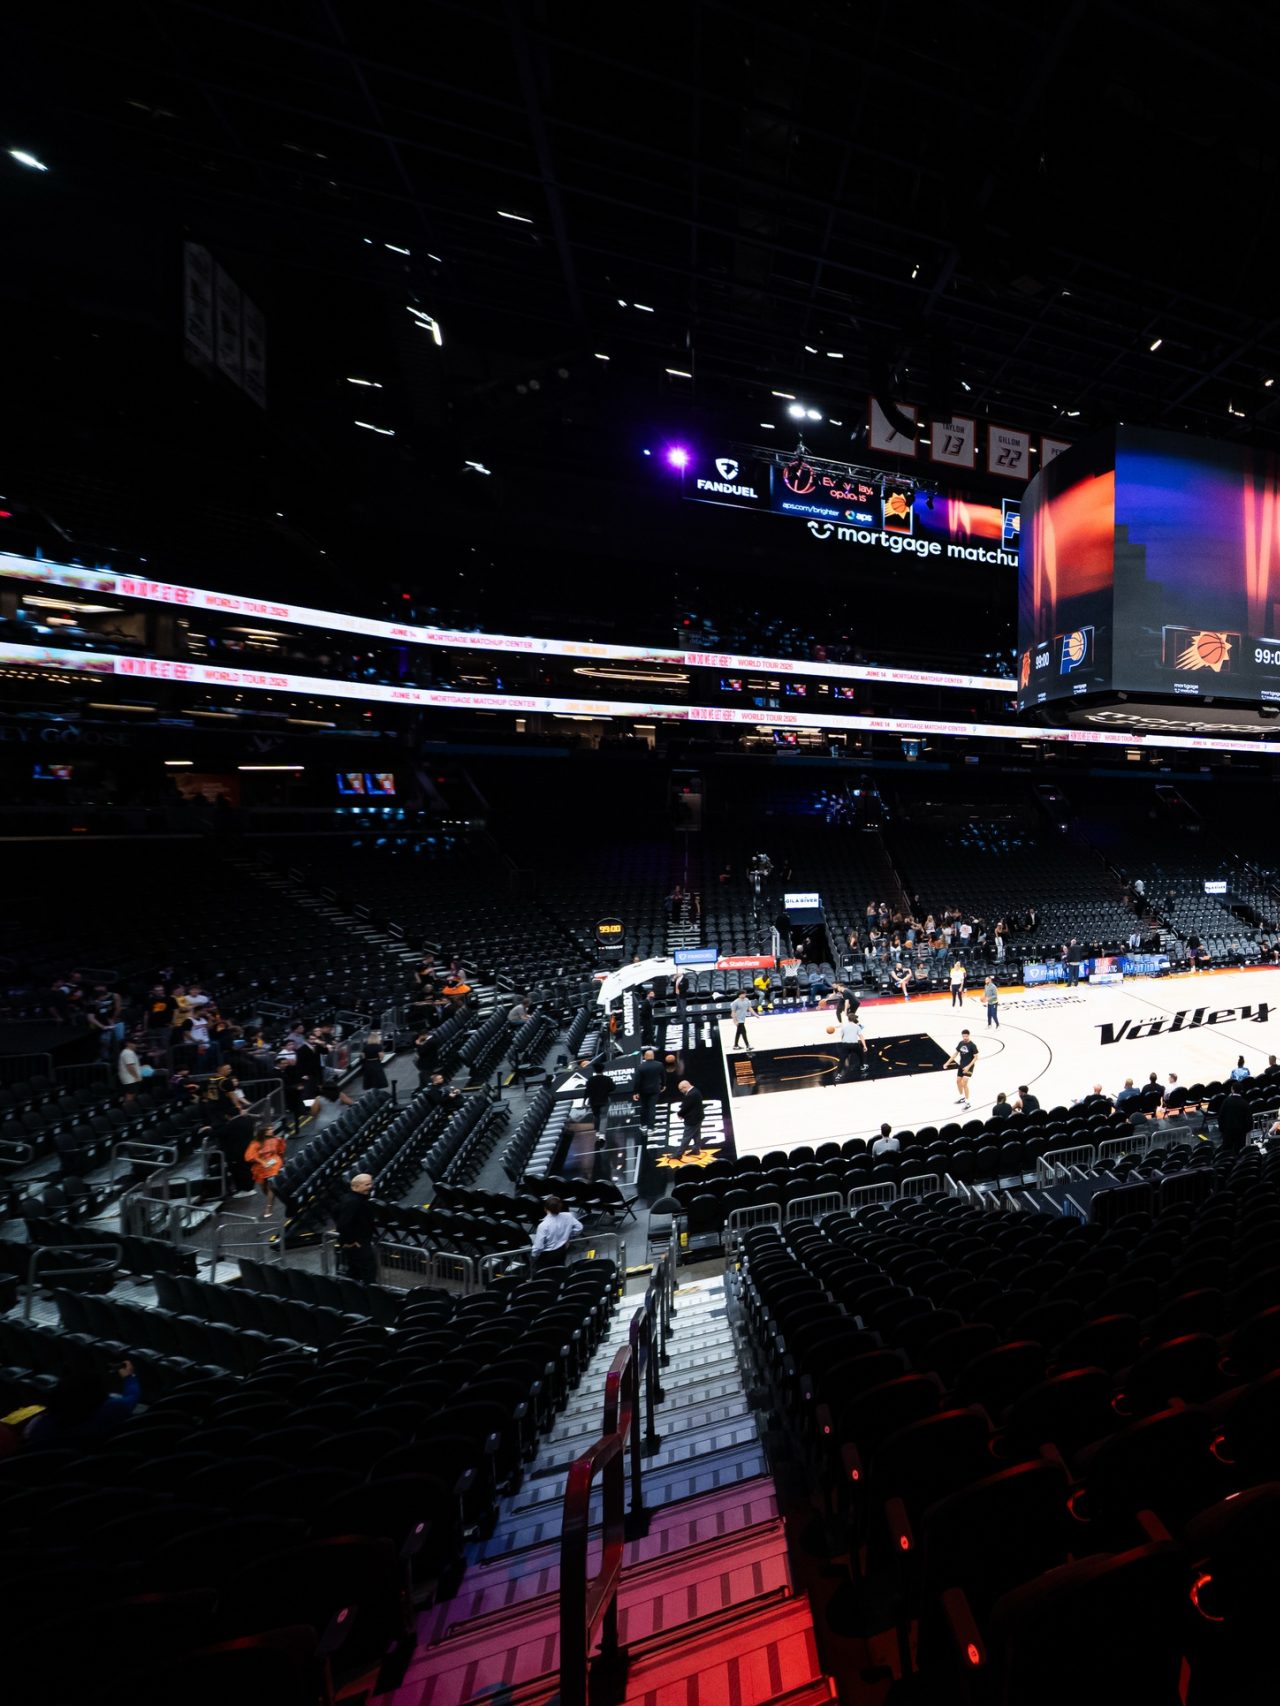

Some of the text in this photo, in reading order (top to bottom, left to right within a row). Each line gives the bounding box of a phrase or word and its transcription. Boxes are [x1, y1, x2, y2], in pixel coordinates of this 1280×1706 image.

[941, 435, 964, 457] 13
[996, 448, 1022, 469] 22
[697, 479, 758, 498] FANDUEL
[782, 501, 839, 517] aps.com/brighter
[856, 511, 872, 522] aps
[838, 525, 1018, 567] mortgage matchu
[1036, 652, 1049, 670] 99:00
[999, 995, 1080, 1006] ortgage
[1094, 1002, 1277, 1045] Valley
